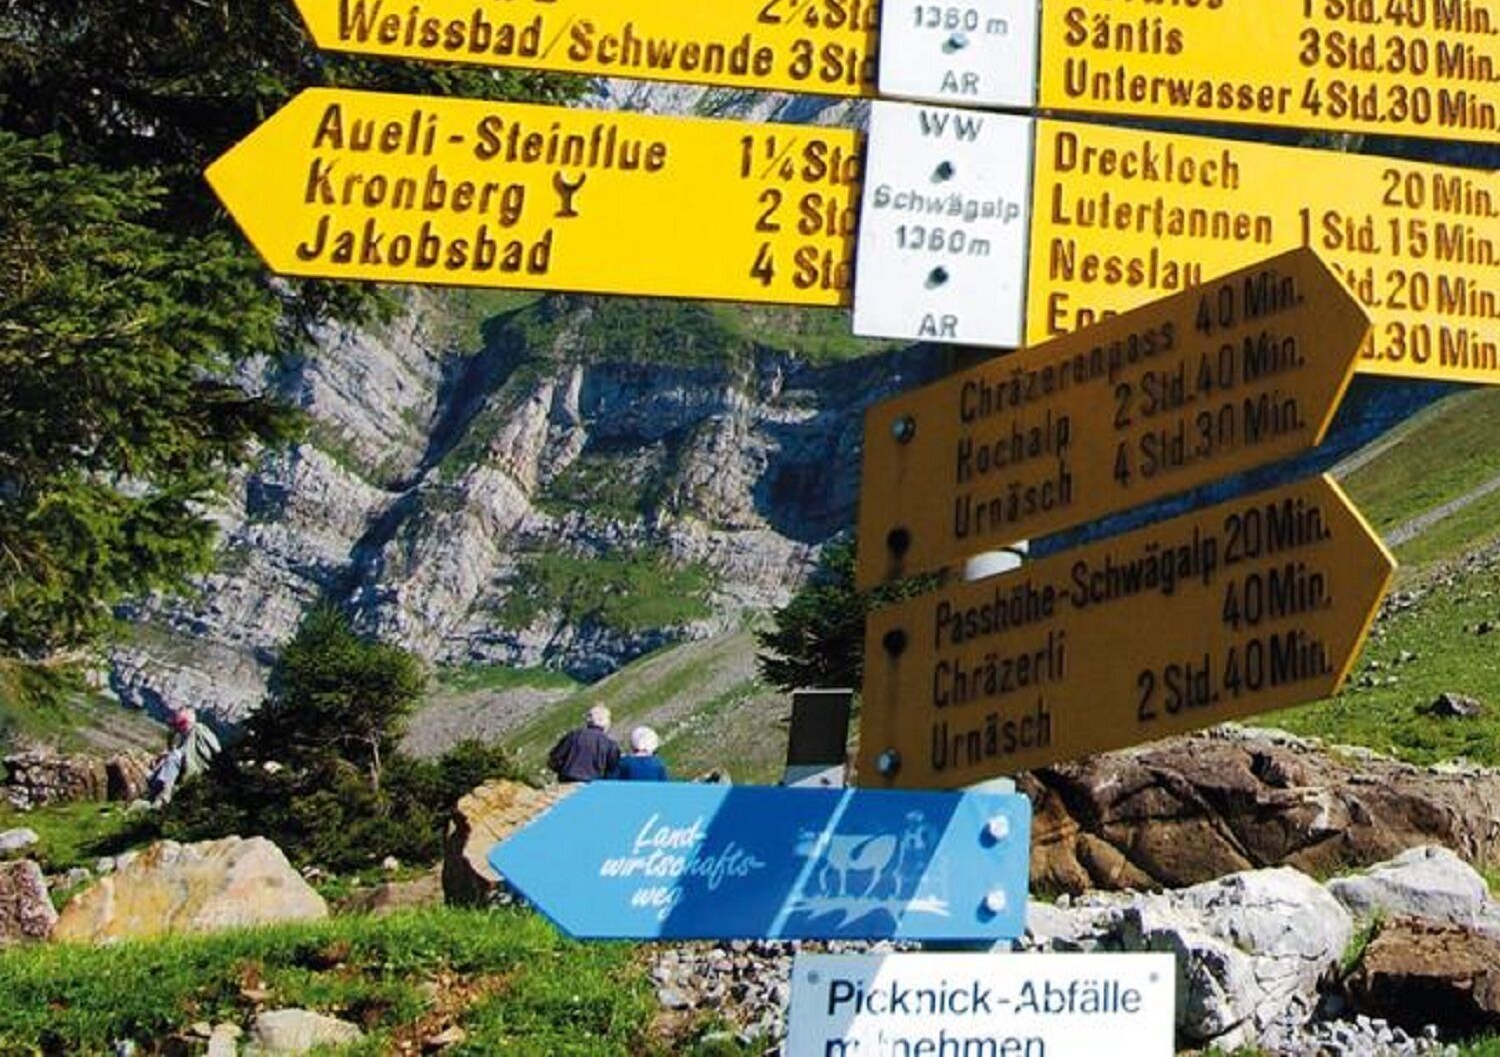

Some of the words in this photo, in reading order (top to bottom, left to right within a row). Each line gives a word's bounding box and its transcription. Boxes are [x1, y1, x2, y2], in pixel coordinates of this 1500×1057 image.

[913, 5, 979, 31] 1360
[1063, 7, 1184, 57] Säntis
[1436, 40, 1500, 84] Min.
[940, 70, 980, 94] AR
[1063, 59, 1291, 114] Unterwasser
[303, 157, 526, 228] Kronberg
[755, 188, 783, 233] 2
[872, 183, 1020, 224] Schwägalp
[1053, 131, 1240, 191] Dreckloch
[1380, 167, 1425, 209] 20
[1432, 172, 1500, 218] Min.
[295, 215, 553, 275] Jakobsbad
[750, 242, 774, 287] 4
[1051, 183, 1273, 245] Lutertannen
[1050, 238, 1201, 292] Nesslau
[918, 313, 959, 338] AR
[960, 318, 1175, 427] Chräzerenpass
[1243, 269, 1304, 325] Min.
[957, 408, 1071, 485] Hochalp
[1114, 383, 1132, 430] 2
[1243, 331, 1304, 387] Min.
[954, 458, 1072, 540] Urnäsch
[1114, 438, 1130, 486] 4
[1243, 393, 1304, 448] Min.
[935, 526, 1216, 649] Passhöhe-Schwägalp
[933, 630, 1067, 710] Chräzerli
[932, 698, 1051, 771] Urnäsch
[1138, 669, 1156, 722] 2
[631, 887, 683, 921] weg
